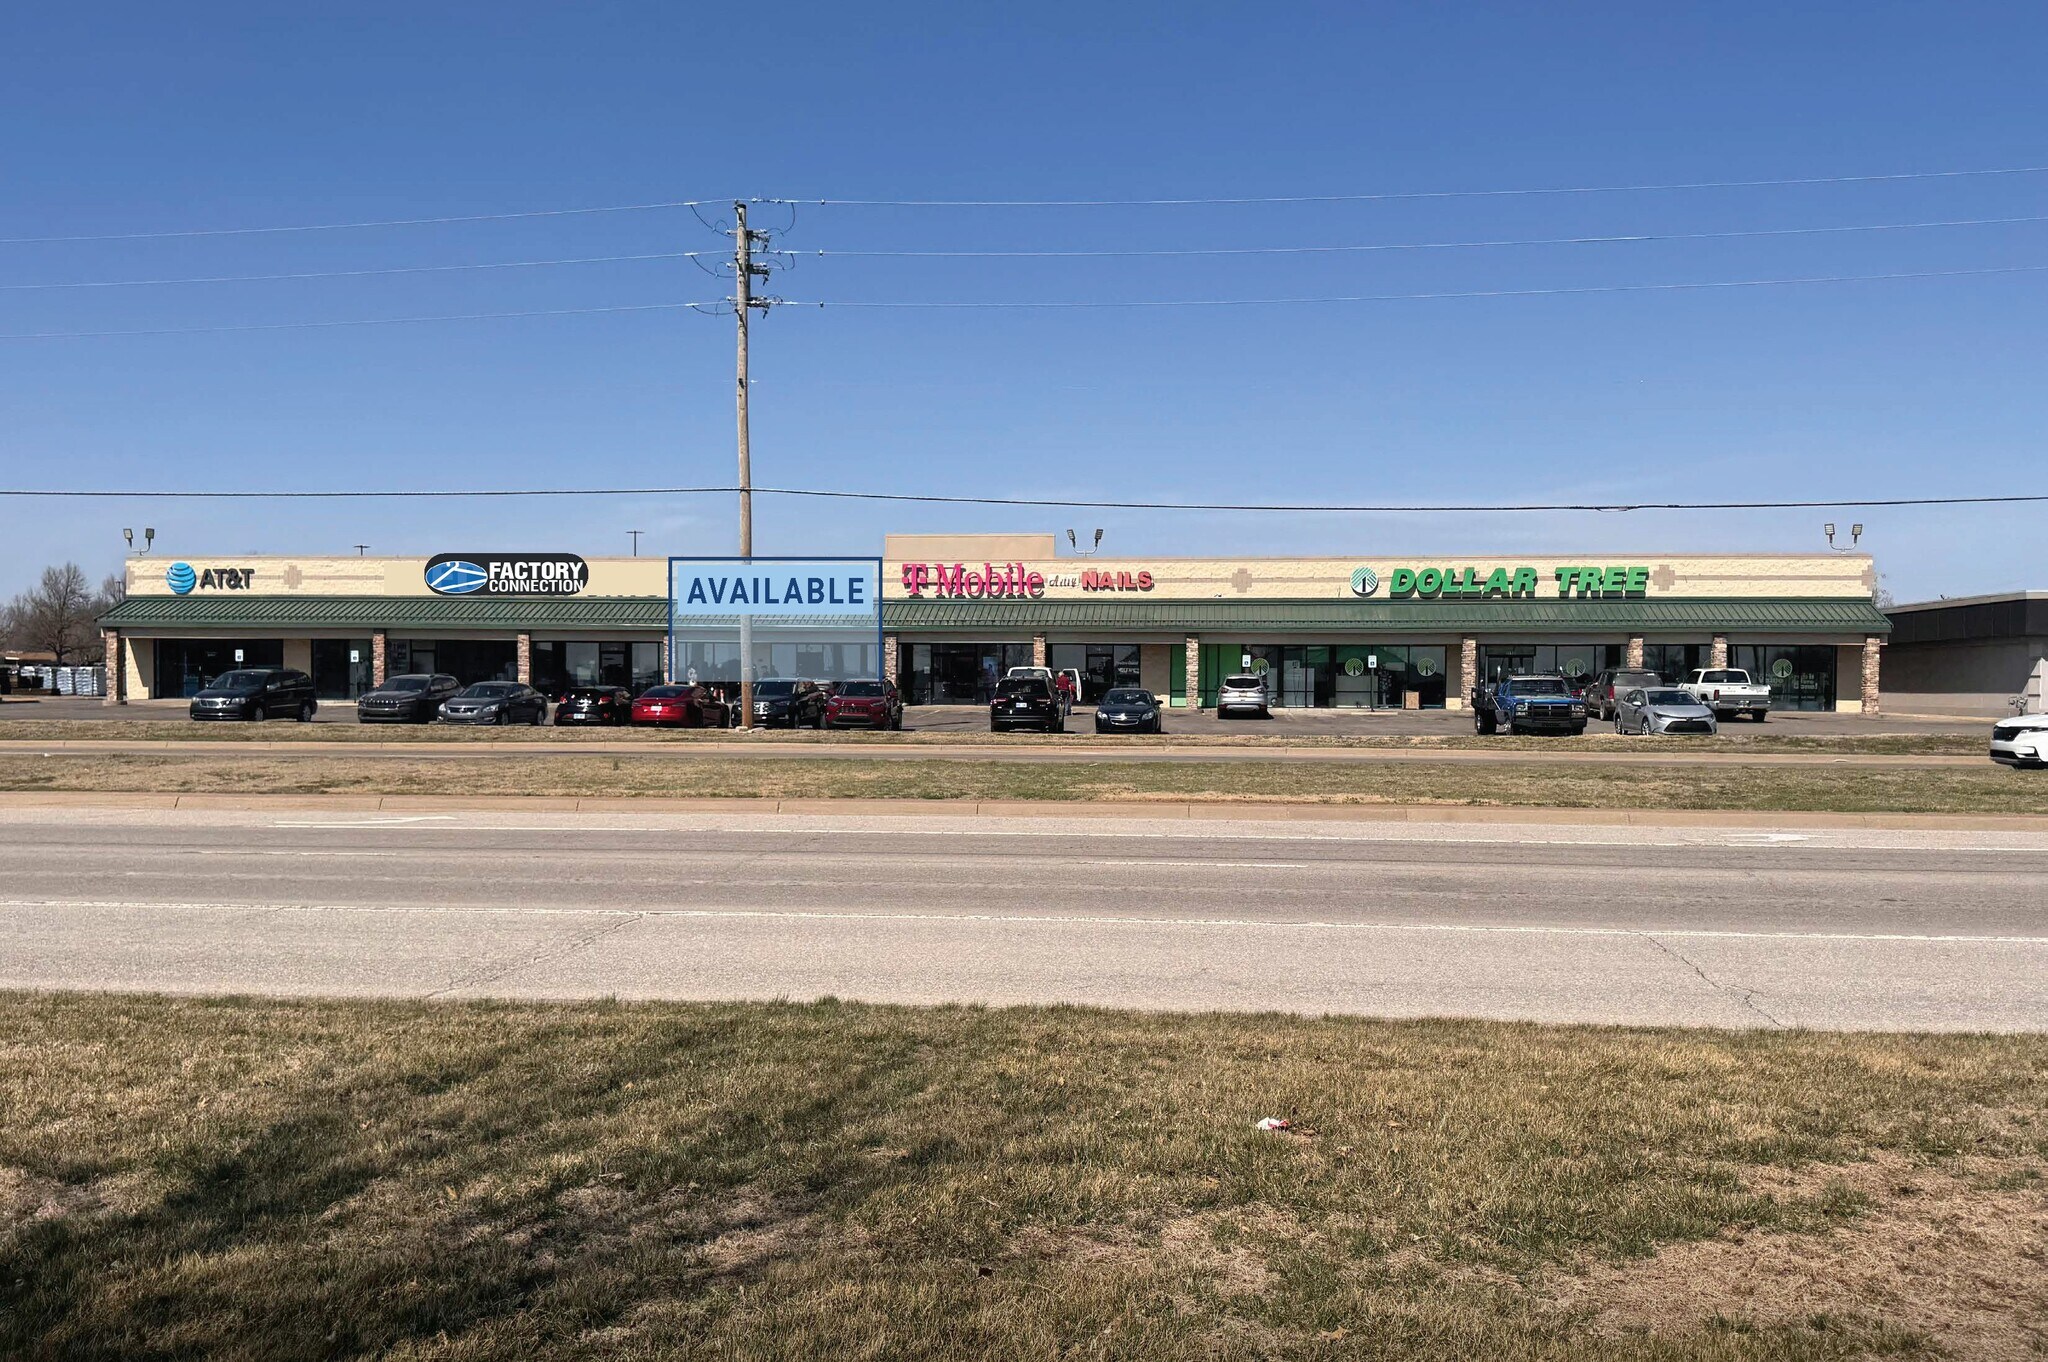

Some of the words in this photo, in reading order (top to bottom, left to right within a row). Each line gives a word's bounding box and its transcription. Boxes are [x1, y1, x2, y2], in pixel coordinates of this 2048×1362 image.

[200, 568, 255, 590] AT&T
[489, 561, 583, 580] FACTORY
[1389, 567, 1538, 594] DOLLAR
[1555, 566, 1649, 592] TREE
[489, 579, 584, 593] CONNECTION
[1081, 571, 1154, 590] NAILS
